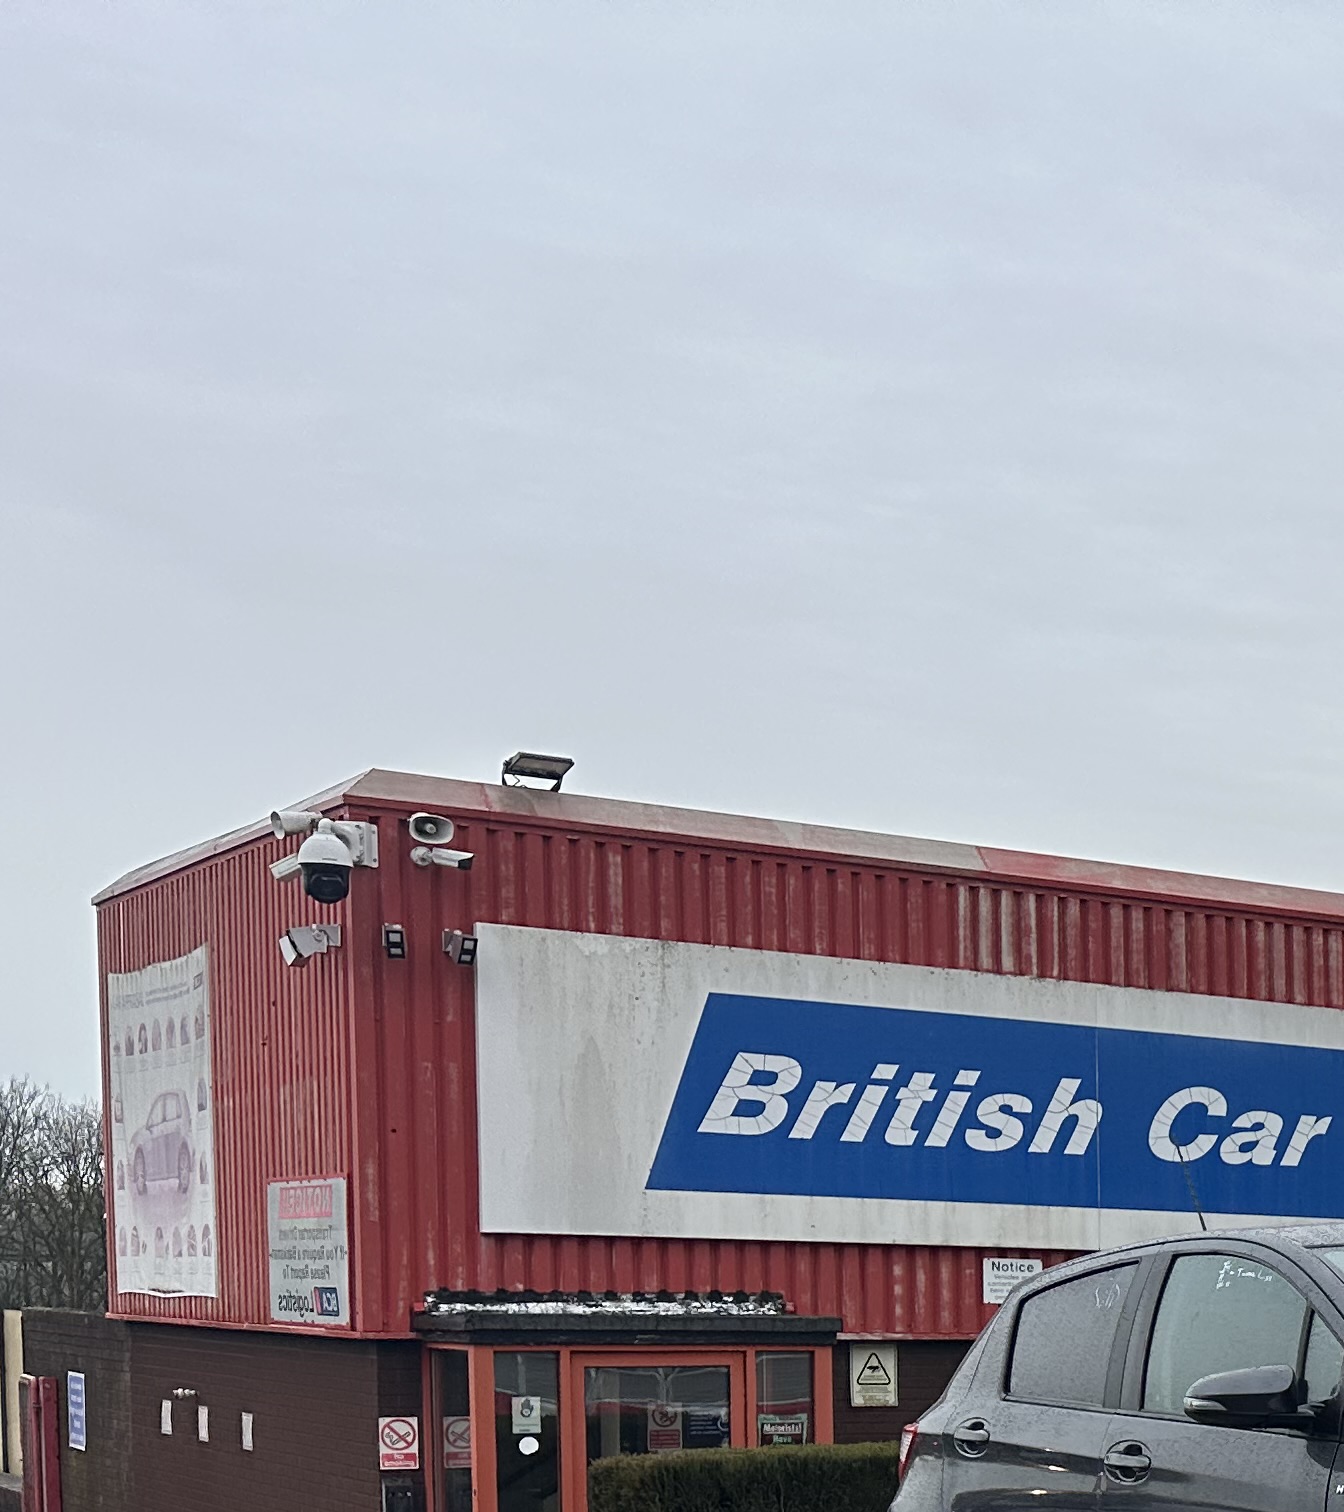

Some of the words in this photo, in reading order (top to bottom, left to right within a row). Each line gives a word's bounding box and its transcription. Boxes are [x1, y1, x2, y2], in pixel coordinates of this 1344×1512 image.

[697, 1051, 1103, 1156] British
[1148, 1086, 1332, 1167] Car
[991, 1261, 1035, 1273] Notice
